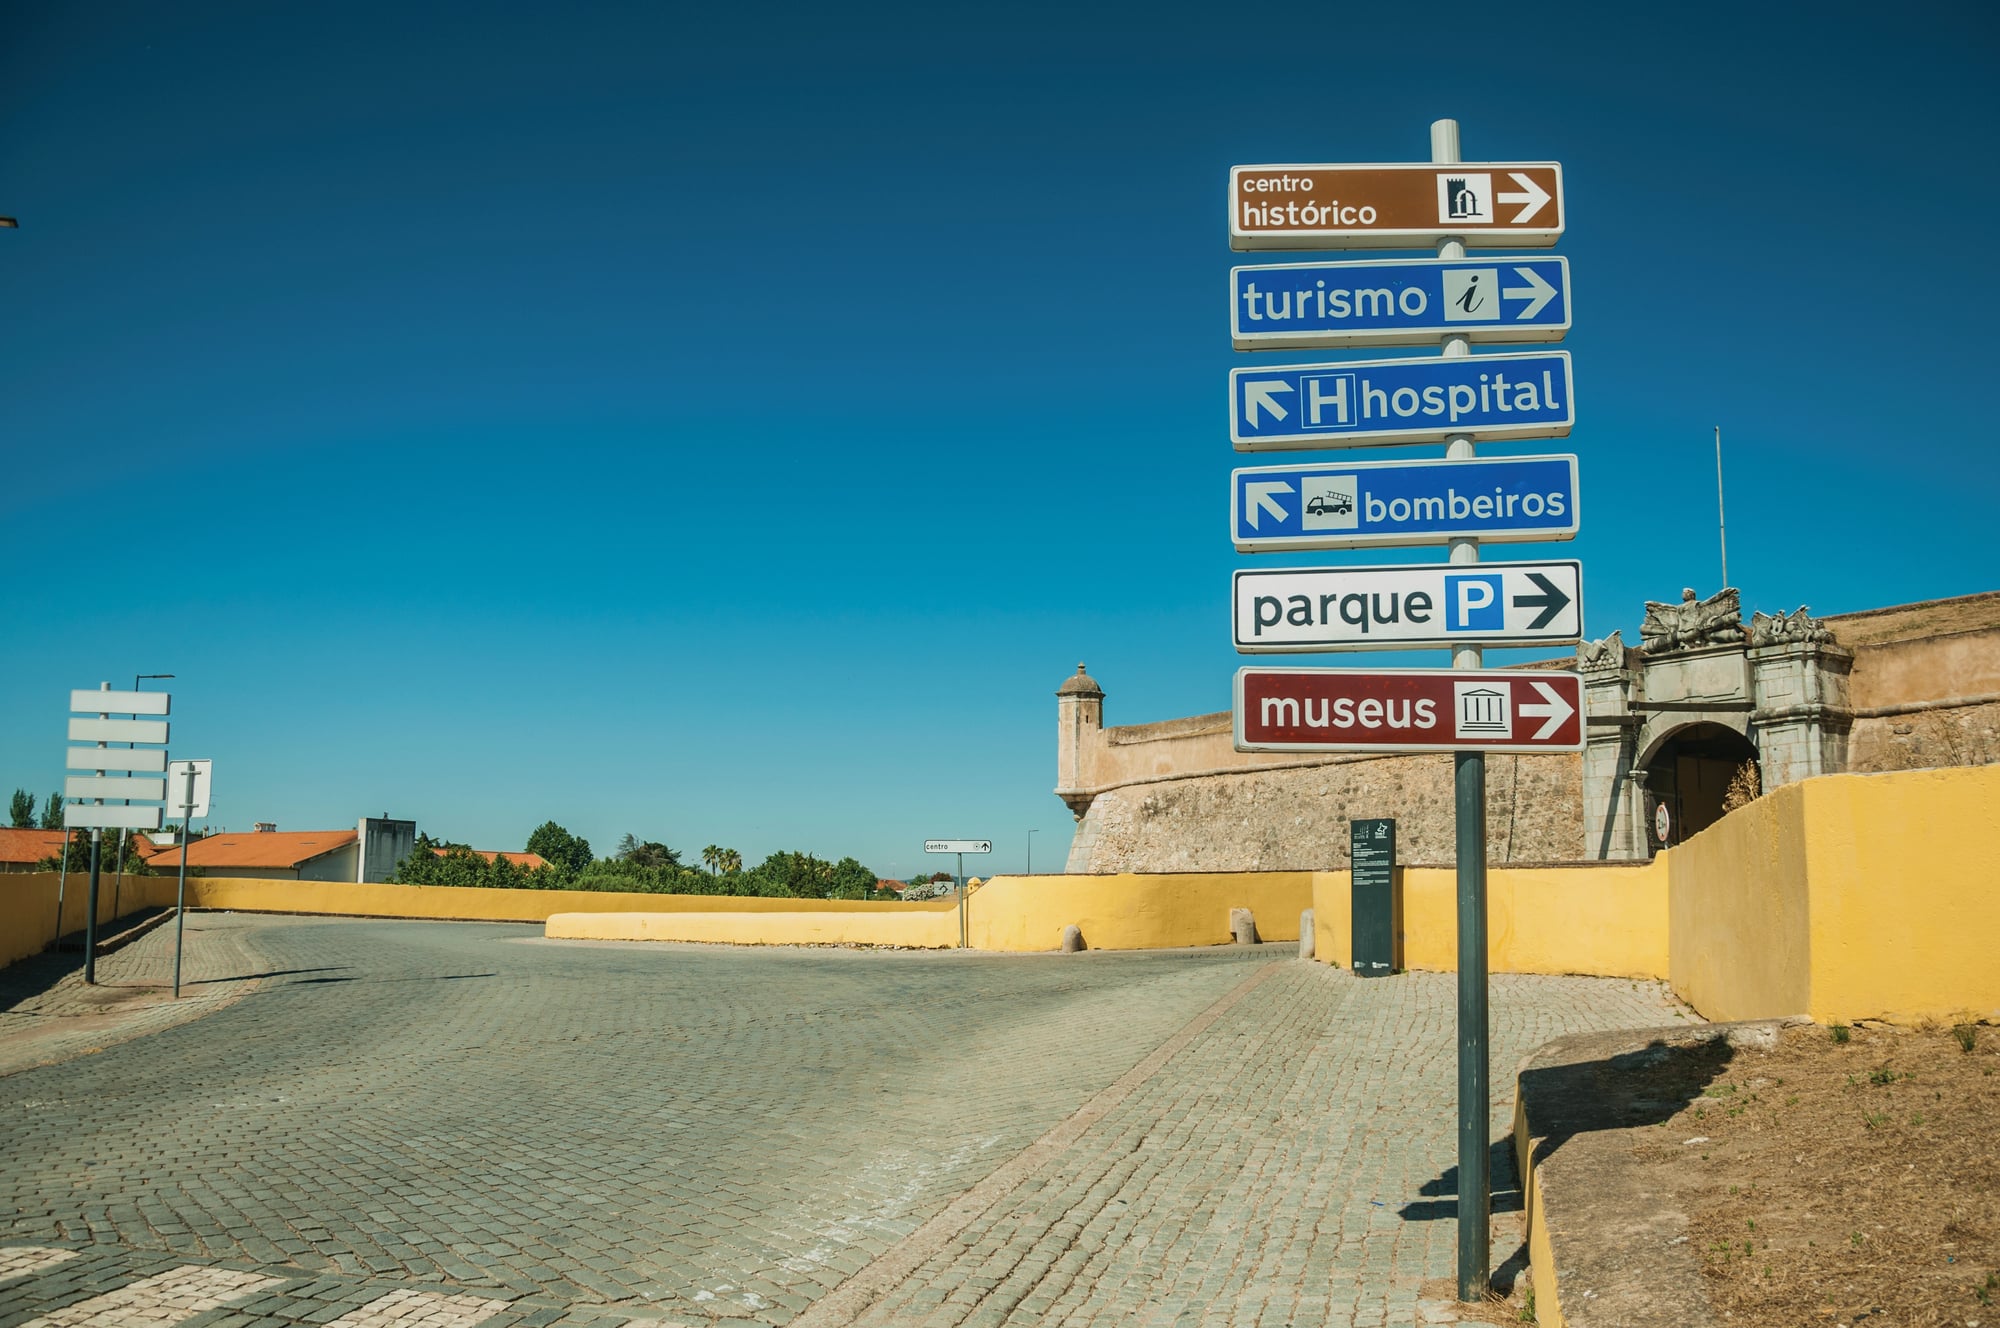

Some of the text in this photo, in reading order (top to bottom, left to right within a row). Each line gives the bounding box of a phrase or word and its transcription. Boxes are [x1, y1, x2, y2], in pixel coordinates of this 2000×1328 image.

[1243, 174, 1313, 192] centro
[1243, 200, 1377, 227] histórico
[1243, 275, 1484, 321] turismo i
[1308, 370, 1560, 424] H hospital
[1365, 487, 1565, 523] bombeiros
[1253, 580, 1495, 636] parque P
[1260, 696, 1437, 729] museus
